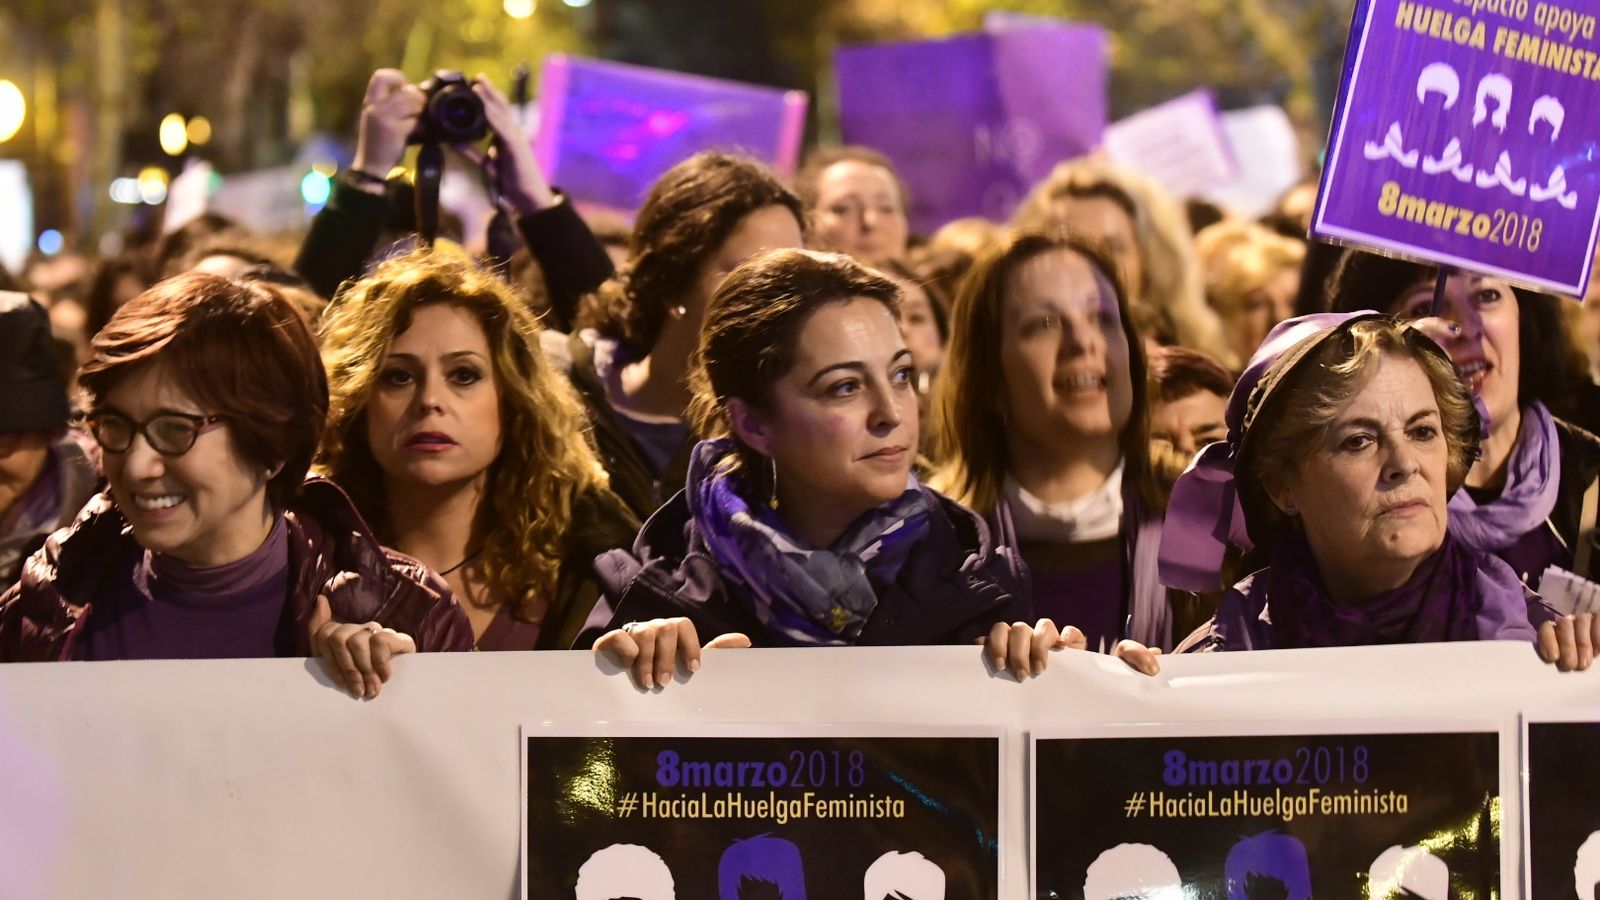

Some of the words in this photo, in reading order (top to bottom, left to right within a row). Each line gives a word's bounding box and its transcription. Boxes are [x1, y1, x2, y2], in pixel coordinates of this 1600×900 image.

[1395, 1, 1486, 50] HUELGA
[1534, 1, 1596, 43] apoya
[1377, 181, 1544, 253] 8marzo2018
[656, 750, 864, 787] 8marzo2018
[1163, 746, 1369, 786] 8marzo2018
[616, 791, 905, 824] #HaciaLaHuelgaFeminista
[1123, 788, 1408, 821] #HaciaLaHuelgaFeminista
